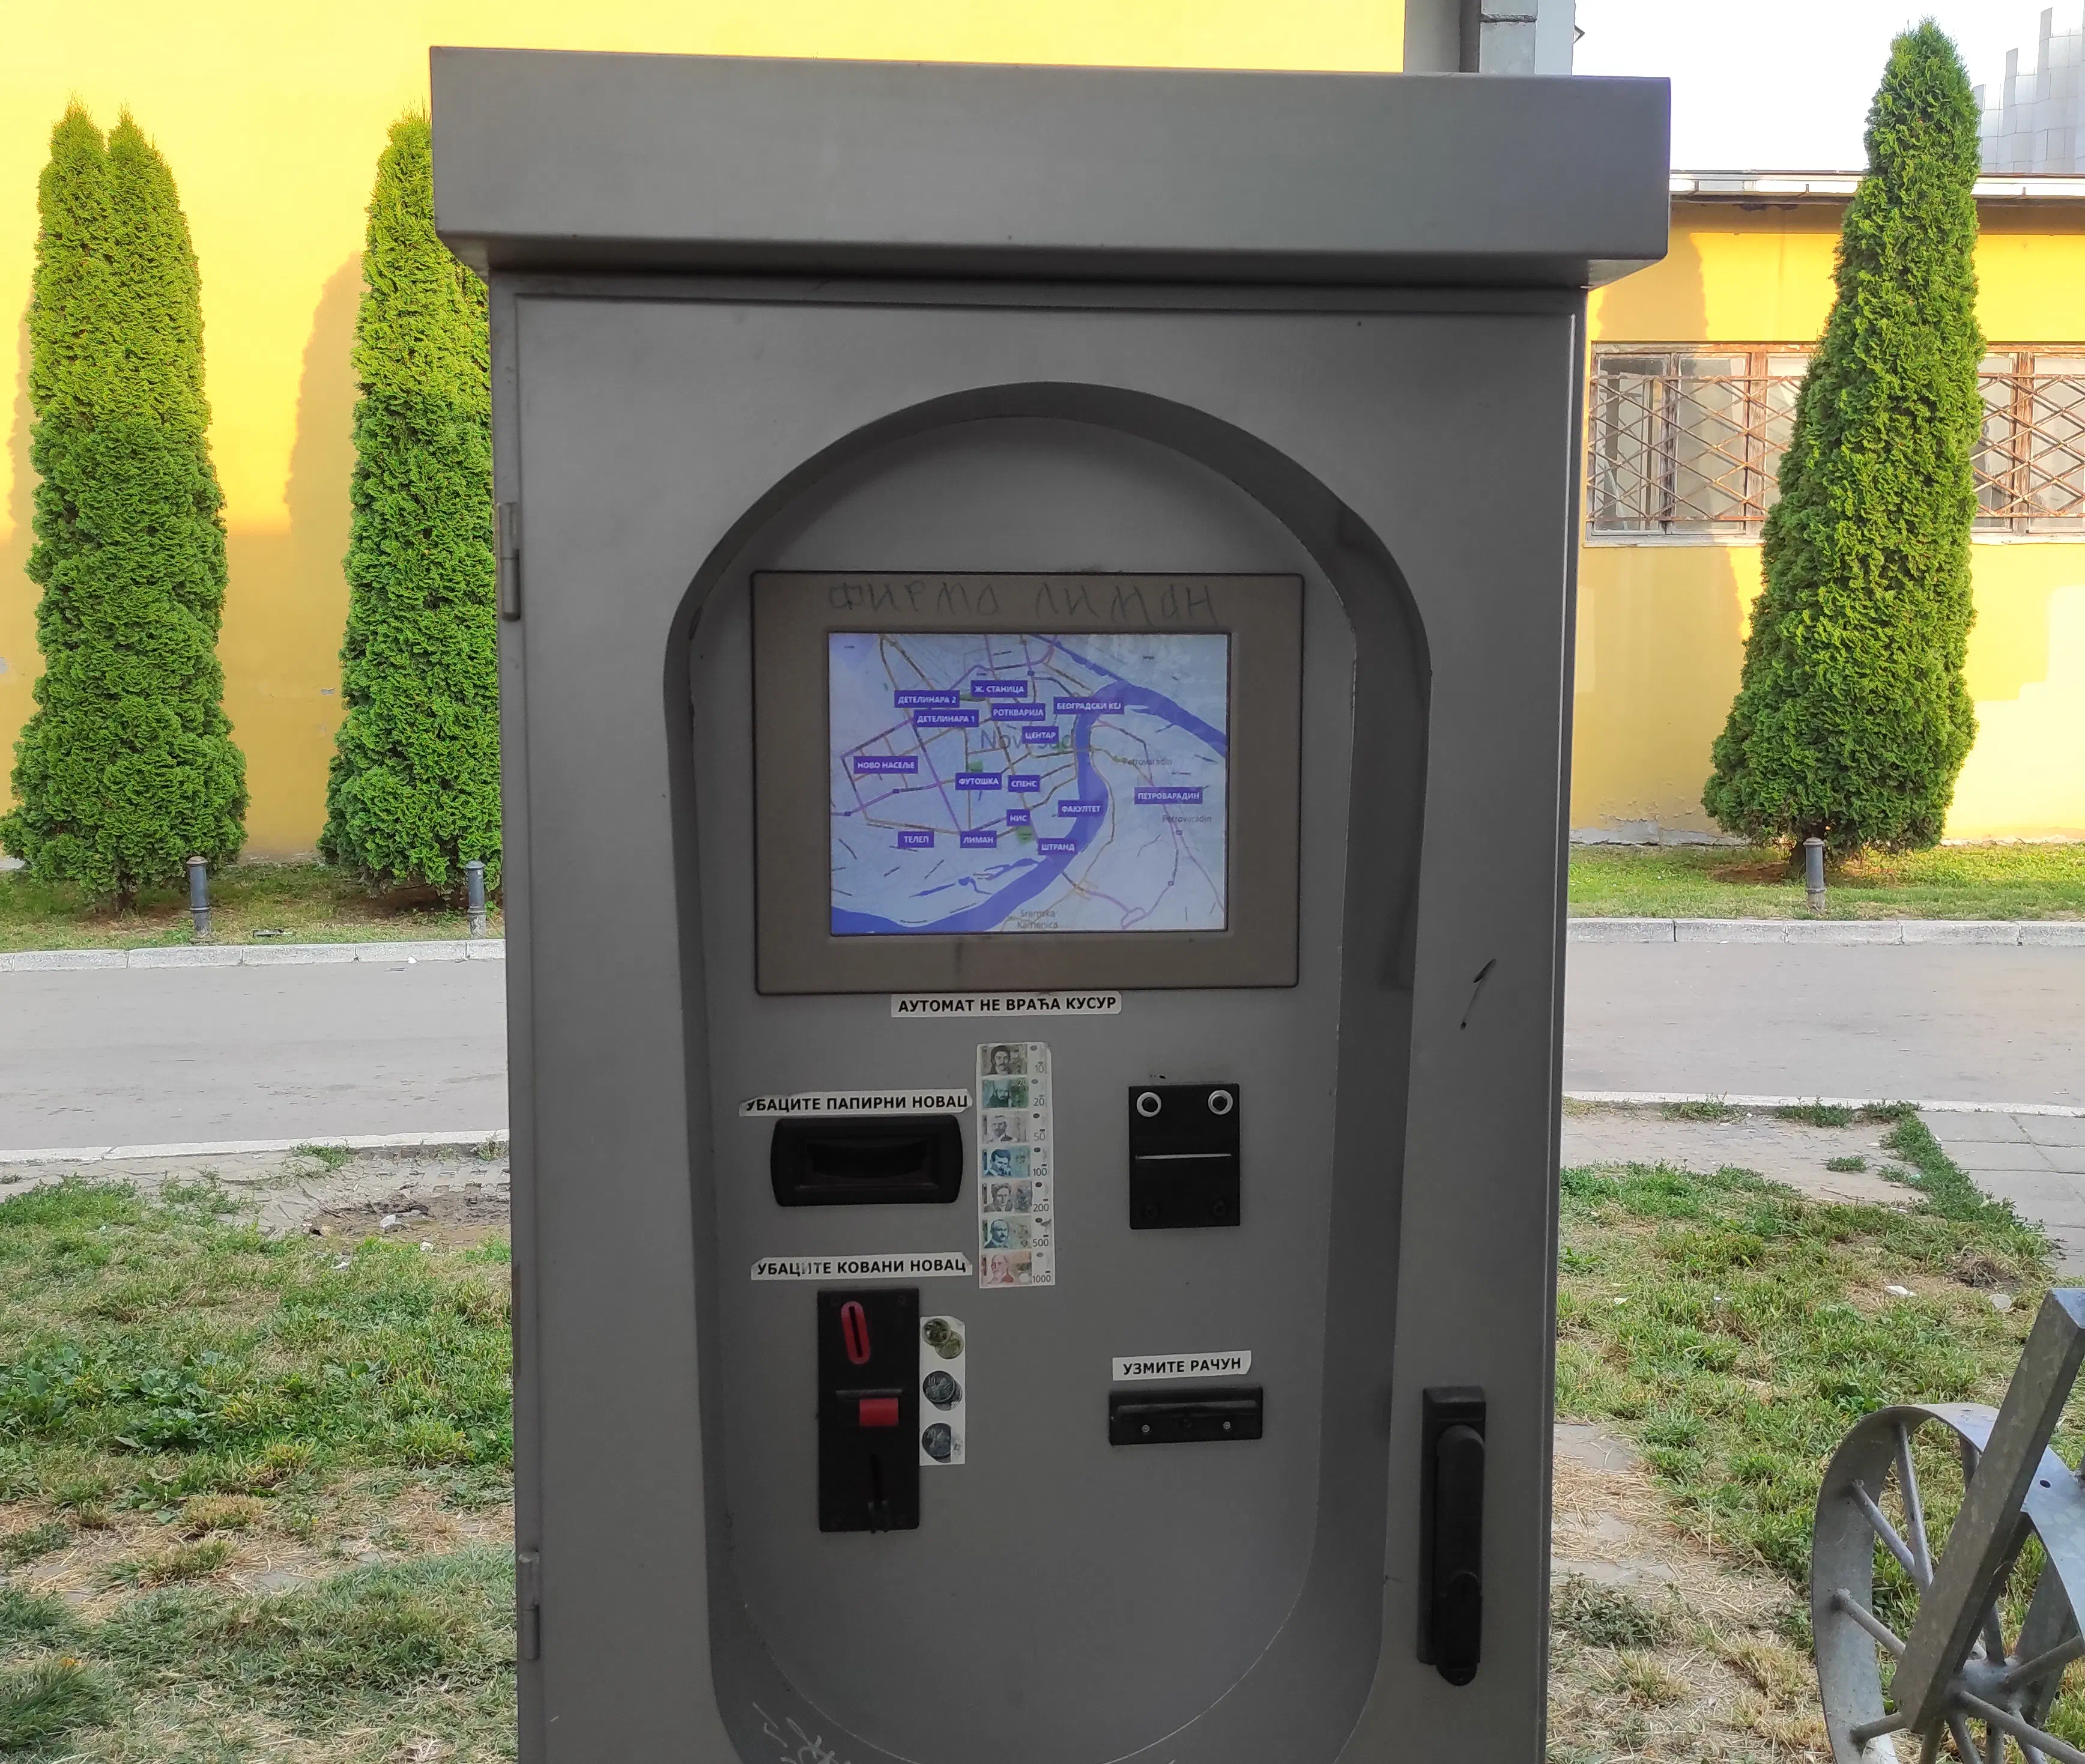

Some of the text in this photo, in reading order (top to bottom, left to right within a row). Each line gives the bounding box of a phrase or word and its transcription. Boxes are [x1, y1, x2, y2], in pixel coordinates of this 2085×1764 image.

[985, 684, 1024, 694] СТАНИЦА
[898, 696, 957, 705] ДЕТЕЛИНАРА 2
[1056, 702, 1106, 711] БЕОГРАДСКИ
[993, 708, 1044, 717] РОТКВАРИЈА
[917, 715, 969, 724] ДЕТЕЛИНАРА
[882, 761, 915, 769] НАСЕЉЕ
[958, 777, 1000, 786] ФУТОШКА
[1011, 780, 1038, 789] СПЕНС
[1137, 792, 1200, 801] ПЕТРОВАРАДИН
[1061, 805, 1102, 814] ФАКУЛТЕТ
[1009, 814, 1027, 822] НИС
[903, 835, 930, 844] ТЕЛЕП
[963, 836, 994, 844] ЛИМАН
[1041, 843, 1076, 852] ШТРАНД
[898, 996, 1117, 1013] АУТОМАТ НЕ ВРАЂА КУСУР
[1034, 1064, 1044, 1074] 10
[746, 1097, 822, 1113] УБАЦИТЕ
[826, 1096, 907, 1110] ПАПИРНИ
[1033, 1097, 1045, 1106] 20
[1033, 1132, 1046, 1141] 50
[1032, 1167, 1048, 1177] 100
[1032, 1203, 1050, 1213] 200
[1032, 1238, 1049, 1247] 500
[757, 1258, 967, 1277] УБАЦИТЕ КОВАНИ НОВАЦ
[1032, 1274, 1052, 1284] 1000
[1123, 1357, 1242, 1375] УЗМИТЕ РАЧУН
